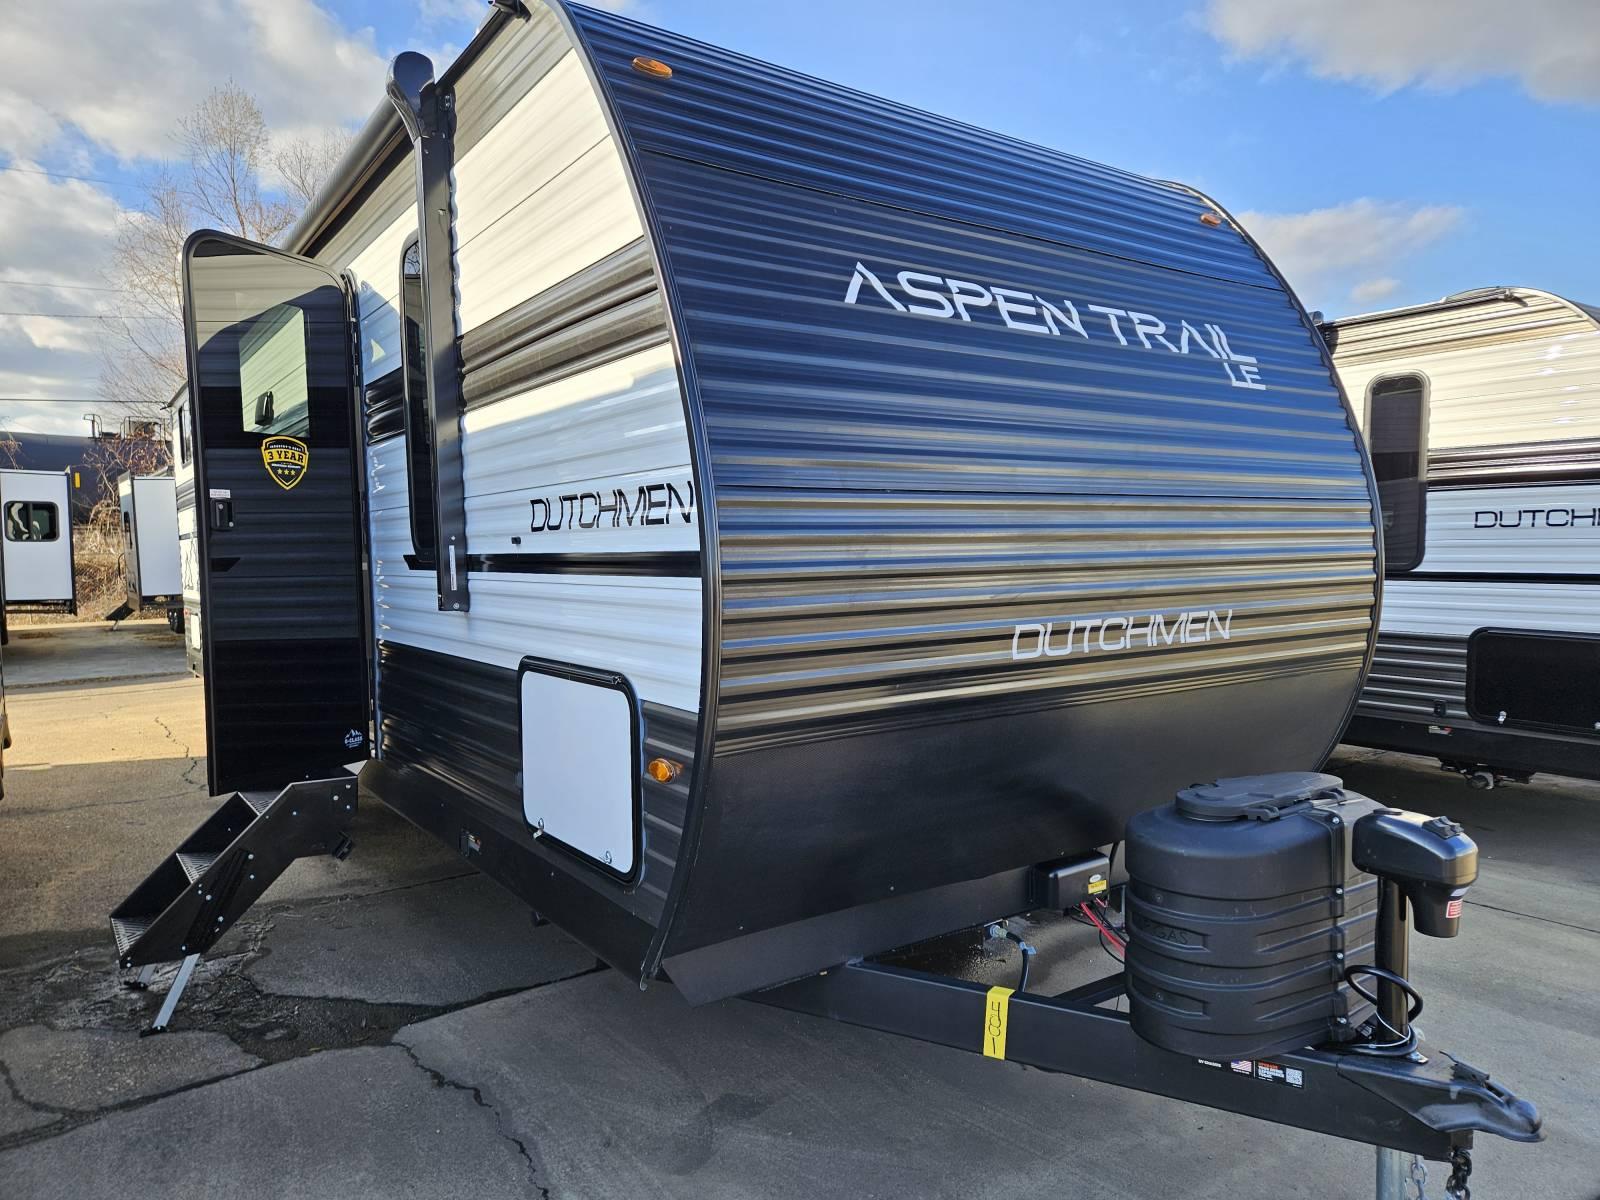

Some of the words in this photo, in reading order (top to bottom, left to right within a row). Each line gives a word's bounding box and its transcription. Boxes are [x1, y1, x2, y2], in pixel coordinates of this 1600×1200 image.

[845, 261, 1088, 339] ASPEN
[1088, 304, 1258, 363] TRAIL
[1223, 361, 1267, 391] LE
[267, 451, 274, 461] 3
[276, 450, 304, 464] YEAR
[530, 481, 694, 532] DUTCHMEN
[1474, 508, 1600, 528] DUTCH
[1012, 609, 1233, 660] DUTCHMEN
